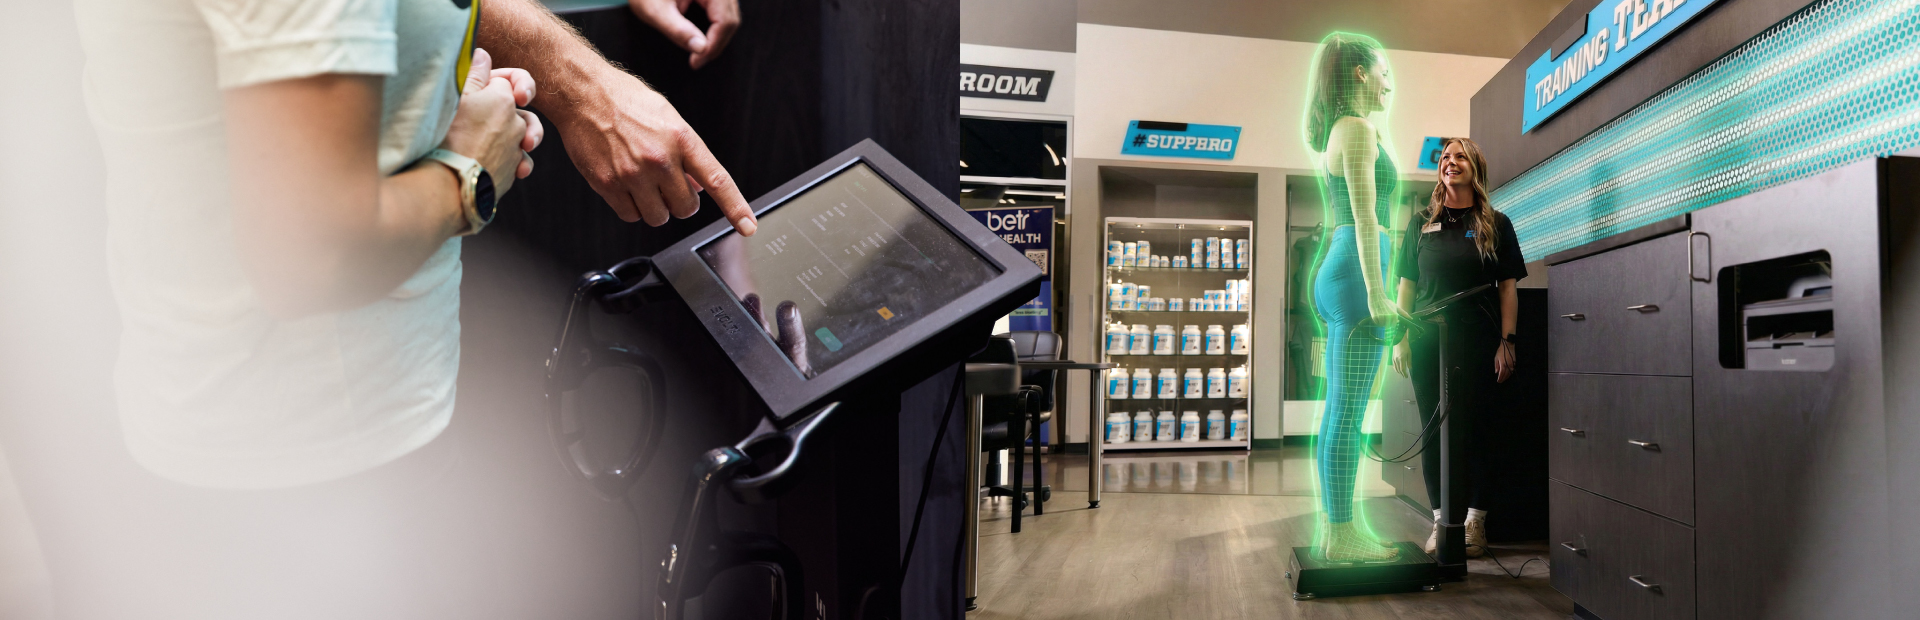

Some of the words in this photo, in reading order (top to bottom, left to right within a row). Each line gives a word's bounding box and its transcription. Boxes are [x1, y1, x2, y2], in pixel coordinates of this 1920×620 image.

[1535, 28, 1609, 112] TRAINING
[1613, 0, 1687, 52] TEA
[960, 72, 1041, 95] ROOM
[987, 210, 1030, 231] betr
